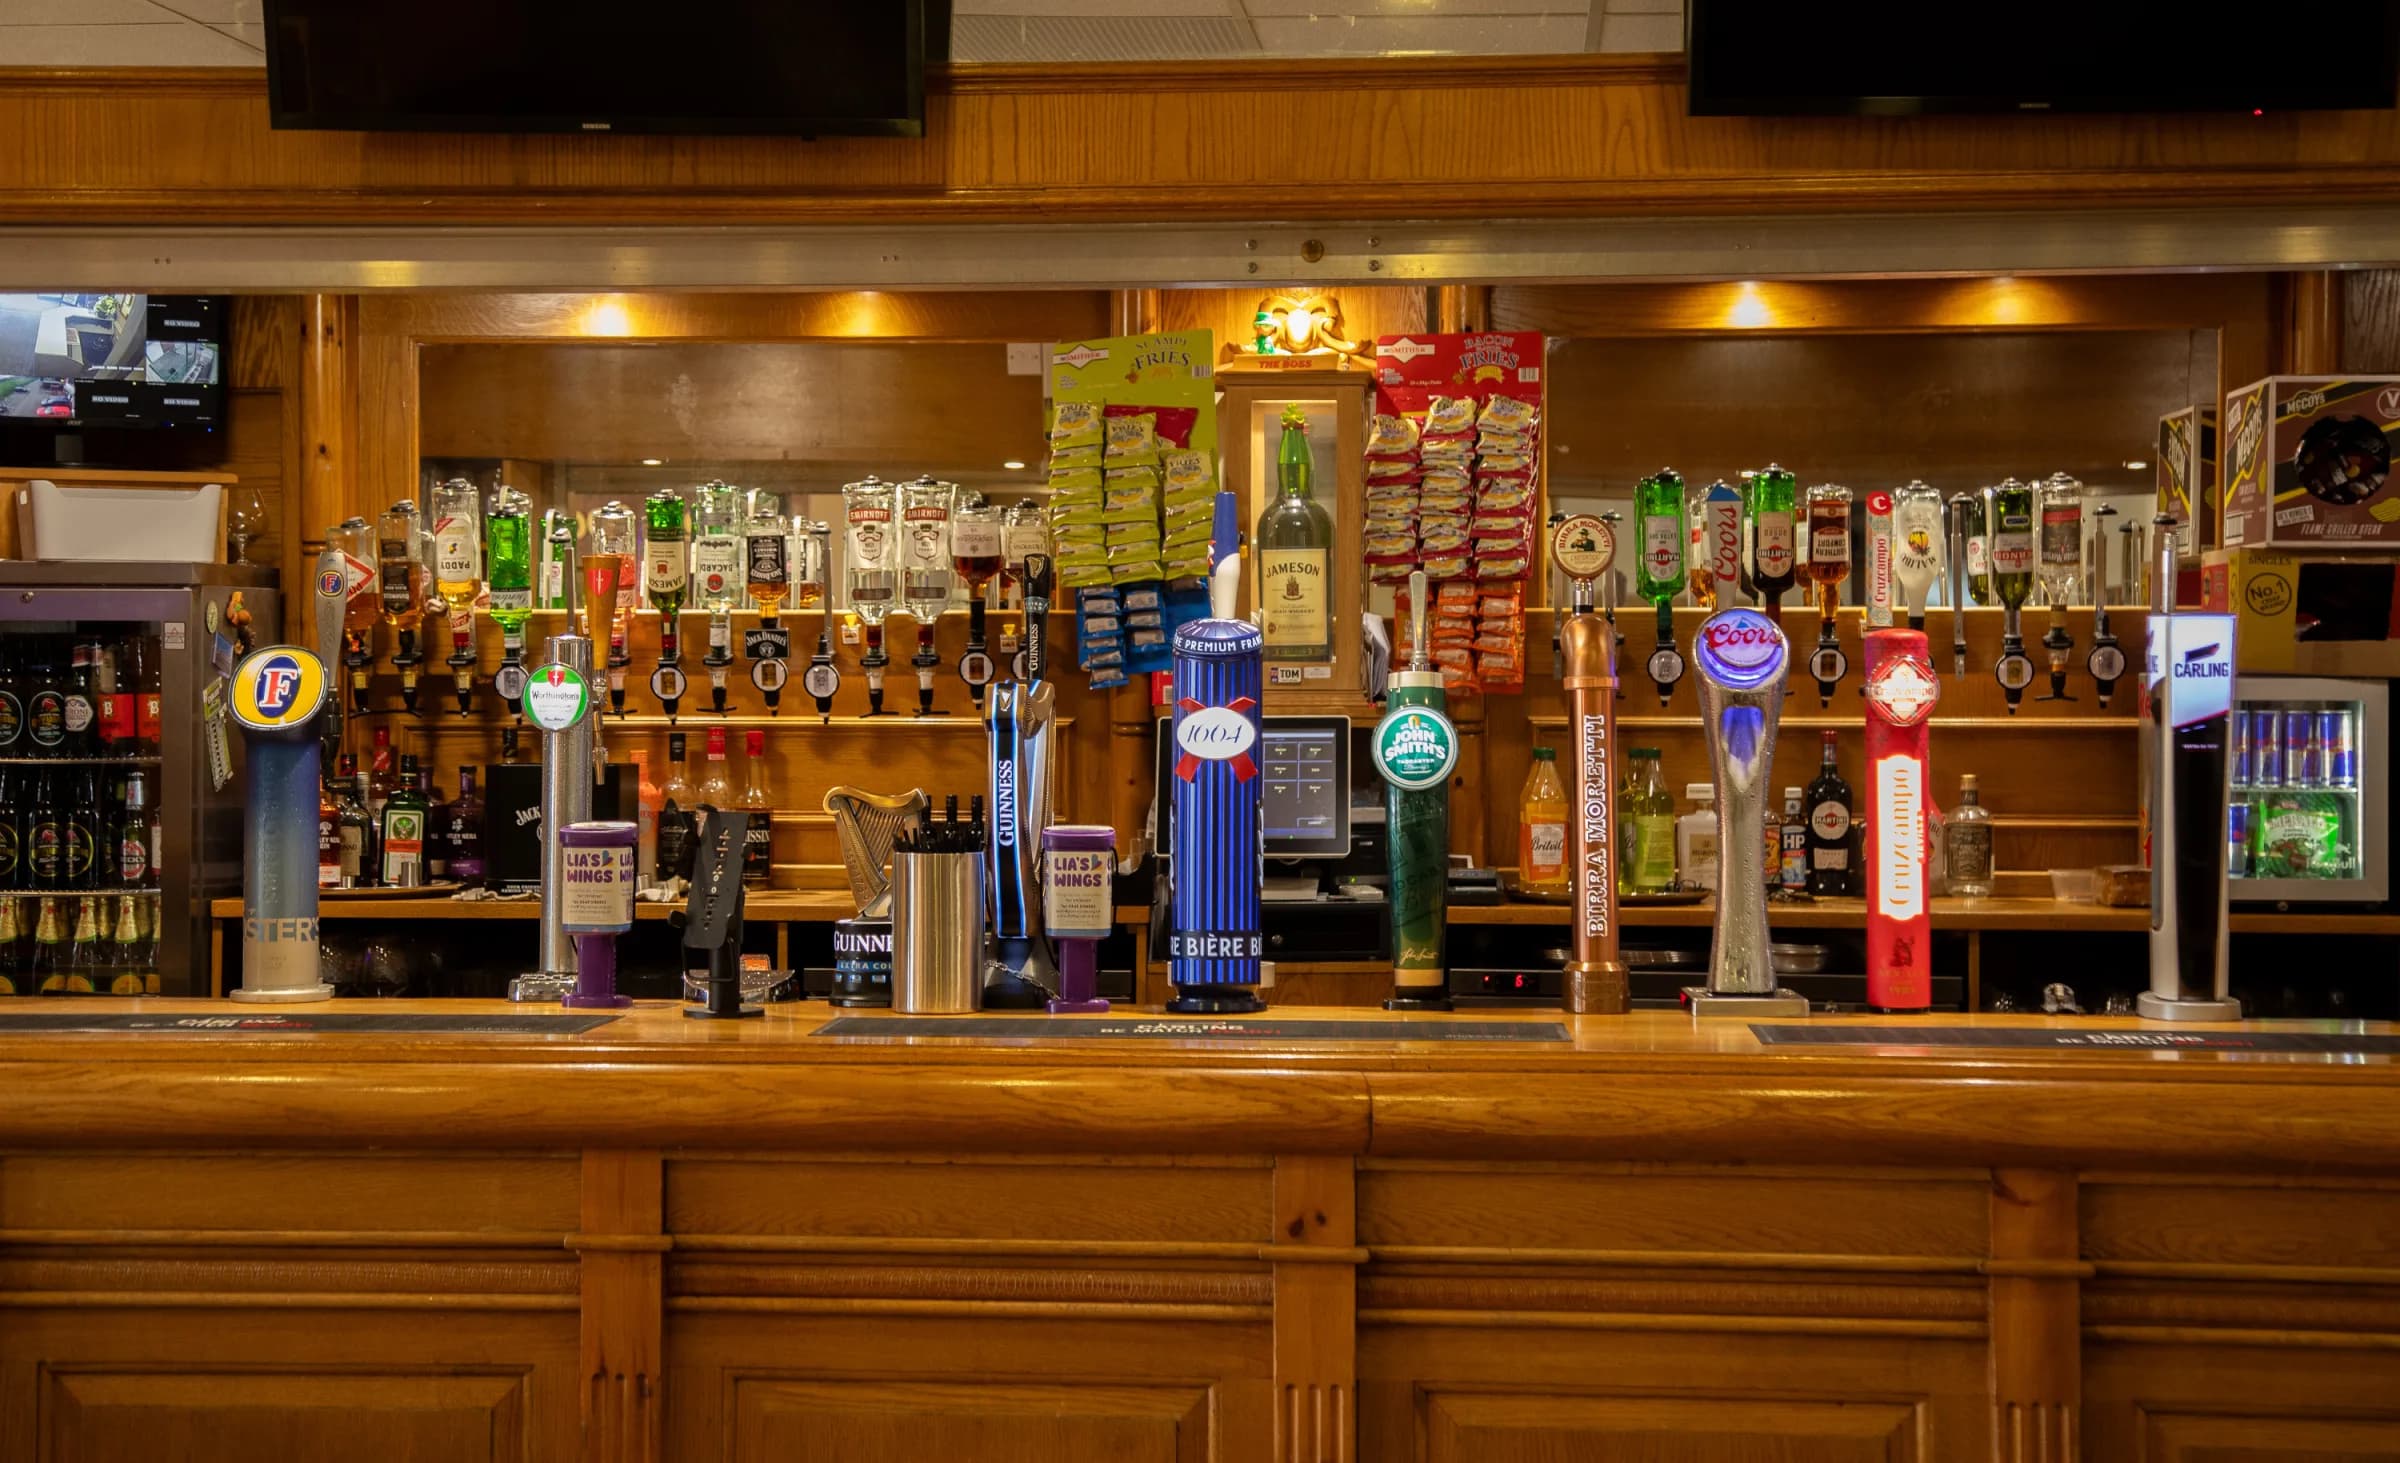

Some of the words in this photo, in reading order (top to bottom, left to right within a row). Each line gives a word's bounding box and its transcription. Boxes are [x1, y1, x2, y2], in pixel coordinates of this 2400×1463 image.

[1464, 335, 1514, 349] BACON
[1135, 350, 1191, 370] FRIES
[1259, 360, 1281, 369] THE
[1282, 359, 1313, 369] BOSS
[1460, 351, 1519, 369] FRIES
[850, 510, 889, 520] SMIRNOFF
[2301, 524, 2326, 535] FLAME
[2327, 524, 2357, 535] GRILLED
[2359, 524, 2383, 535] STEAK
[1714, 505, 1738, 582] Coors
[439, 559, 471, 570] PADDY
[1646, 553, 1681, 562] MARTINI
[1266, 562, 1320, 578] JAMESON
[1875, 538, 1887, 603] Cruzcampo
[747, 632, 762, 647] JACK
[1184, 639, 1237, 653] PREMIUM
[1240, 634, 1263, 650] FRAN
[1704, 624, 1782, 649] Coors
[1029, 623, 1039, 672] GUINNESS
[1279, 669, 1300, 679] TOM
[2174, 662, 2230, 679] CARLING
[259, 668, 298, 708] F
[1392, 729, 1436, 746] JOHN
[1384, 741, 1447, 762] SMITH'S
[1584, 714, 1607, 843] MORETTI
[999, 760, 1014, 848] GUINNESS
[515, 805, 542, 826] JACK
[1814, 816, 1849, 826] MARTINI
[1783, 833, 1806, 849] HP
[566, 852, 602, 868] LIA'S
[1054, 856, 1090, 871] LIA'S
[566, 869, 614, 884] WINGS
[1054, 873, 1102, 888] WINGS
[1586, 848, 1608, 937] BIRRA
[1186, 932, 1245, 957] BIÈRE
